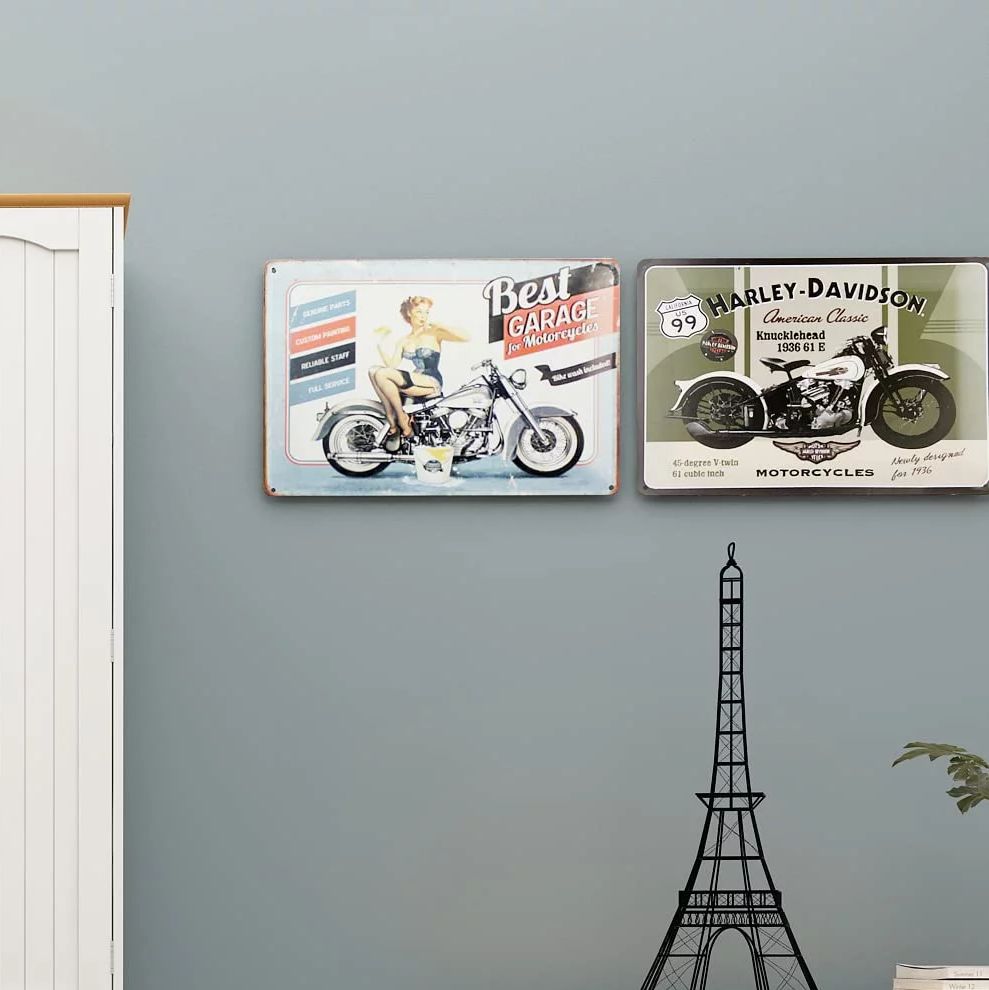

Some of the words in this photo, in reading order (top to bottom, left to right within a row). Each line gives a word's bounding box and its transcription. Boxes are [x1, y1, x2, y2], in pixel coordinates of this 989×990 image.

[483, 266, 571, 317] Best
[302, 305, 329, 318] GENUINE
[329, 299, 351, 310] PARTS
[665, 300, 693, 311] CALIFORNIA
[508, 297, 599, 338] GARAGE
[763, 308, 823, 323] American
[826, 307, 870, 323] Classic
[671, 315, 696, 333] 99
[295, 332, 322, 346] CUSTOM
[322, 326, 350, 339] PAINTING
[507, 342, 521, 355] for
[522, 322, 599, 349] Motorcycles
[756, 330, 825, 340] Knucklehead
[777, 343, 801, 352] 1936
[803, 343, 815, 352] 61
[818, 343, 826, 352] E
[301, 357, 330, 370] RELIABLE
[330, 351, 350, 362] STAFF
[567, 368, 584, 378] wash
[308, 384, 323, 394] FULL
[324, 377, 350, 389] SERVICE
[672, 459, 712, 468] 45-degree
[713, 458, 739, 467] V-twin
[891, 456, 920, 466] Newly
[923, 448, 965, 462] designed
[672, 470, 681, 478] 61
[684, 469, 706, 478] cubic
[707, 469, 725, 478] inch
[756, 468, 875, 477] MOTORCYCLES
[891, 469, 907, 481] for
[911, 466, 933, 476] 1936
